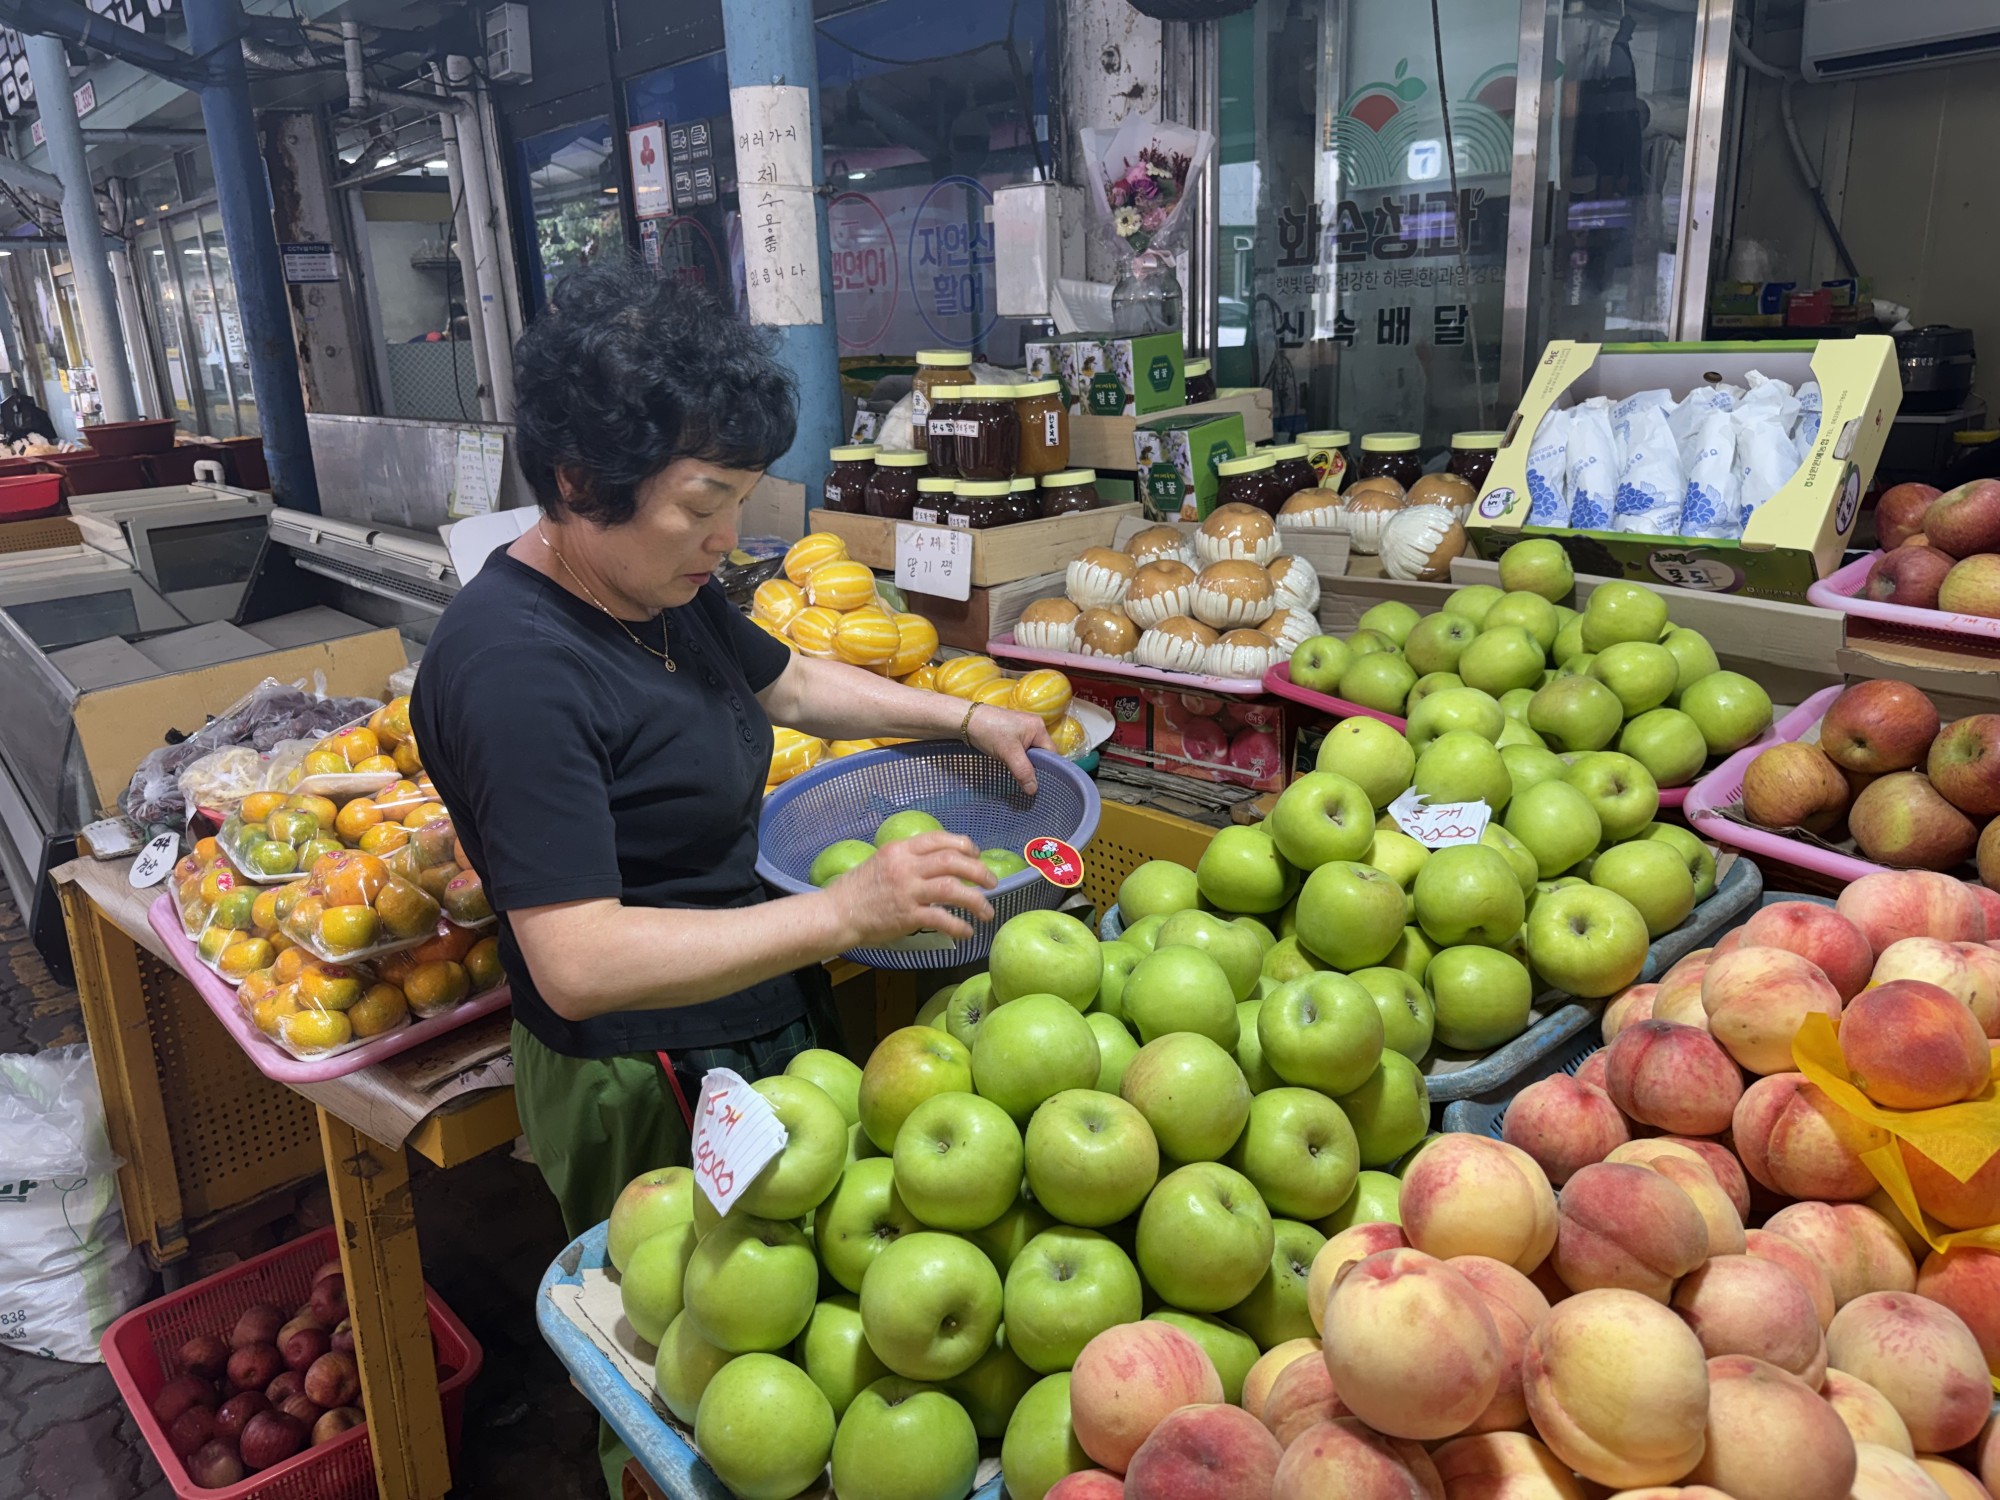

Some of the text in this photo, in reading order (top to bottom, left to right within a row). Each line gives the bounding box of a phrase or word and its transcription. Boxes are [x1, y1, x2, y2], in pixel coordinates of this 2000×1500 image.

[739, 125, 796, 152] 여러가지
[1335, 270, 1378, 292] 건강한
[933, 273, 984, 317] 활어
[1544, 350, 1559, 365] 3kg
[1096, 391, 1118, 405] 벌꿀
[1155, 480, 1176, 495] 벌꿀
[916, 533, 942, 551] 수제
